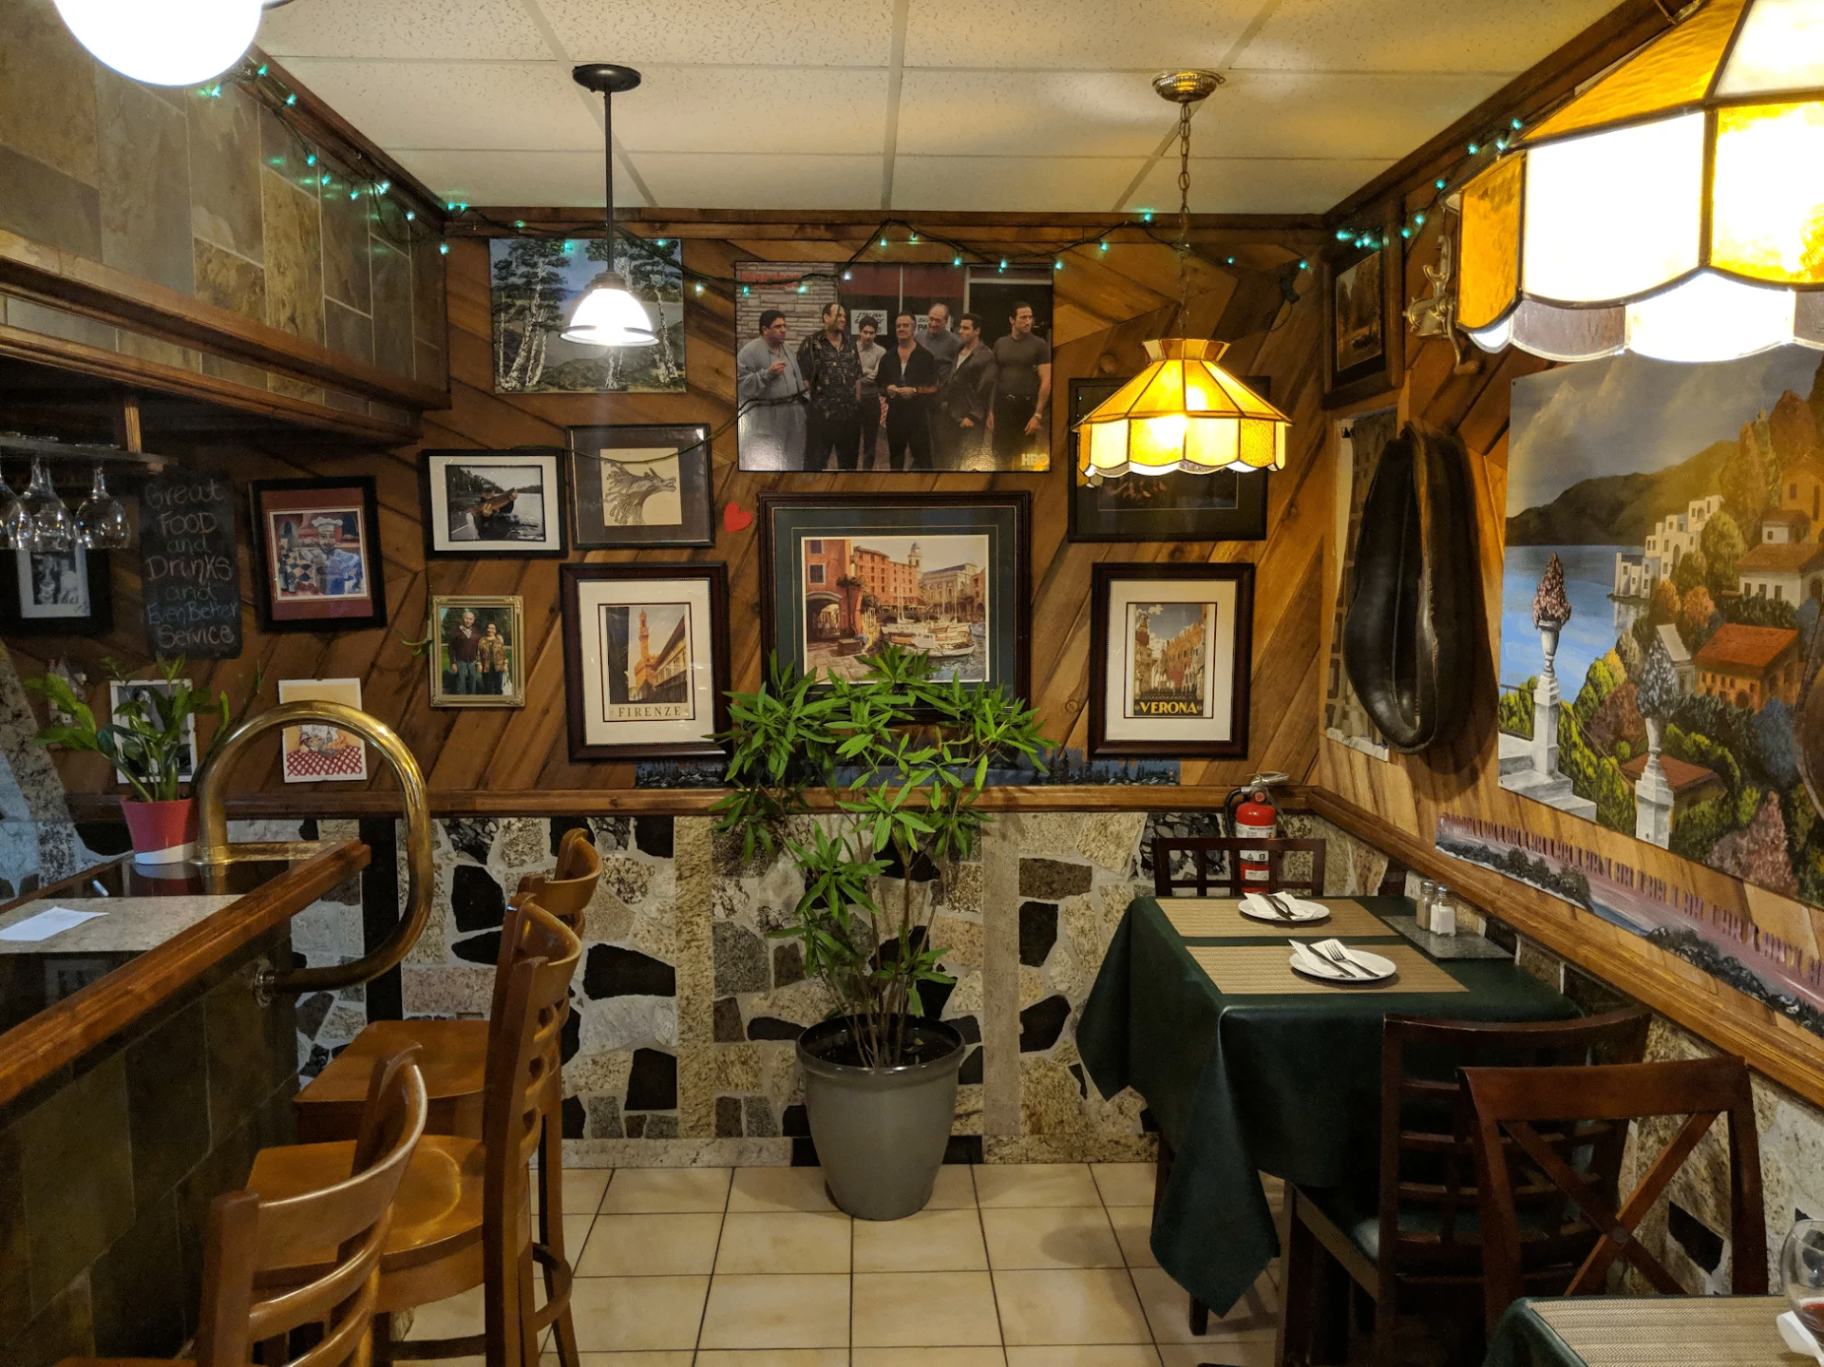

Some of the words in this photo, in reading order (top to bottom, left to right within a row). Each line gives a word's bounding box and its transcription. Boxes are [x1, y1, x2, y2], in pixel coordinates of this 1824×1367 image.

[1021, 453, 1050, 466] HBO
[145, 479, 223, 508] Great
[158, 510, 218, 537] FOOD
[167, 535, 211, 555] and
[165, 582, 218, 600] and
[618, 706, 681, 717] FIRENZE
[1140, 701, 1198, 714] VERONA
